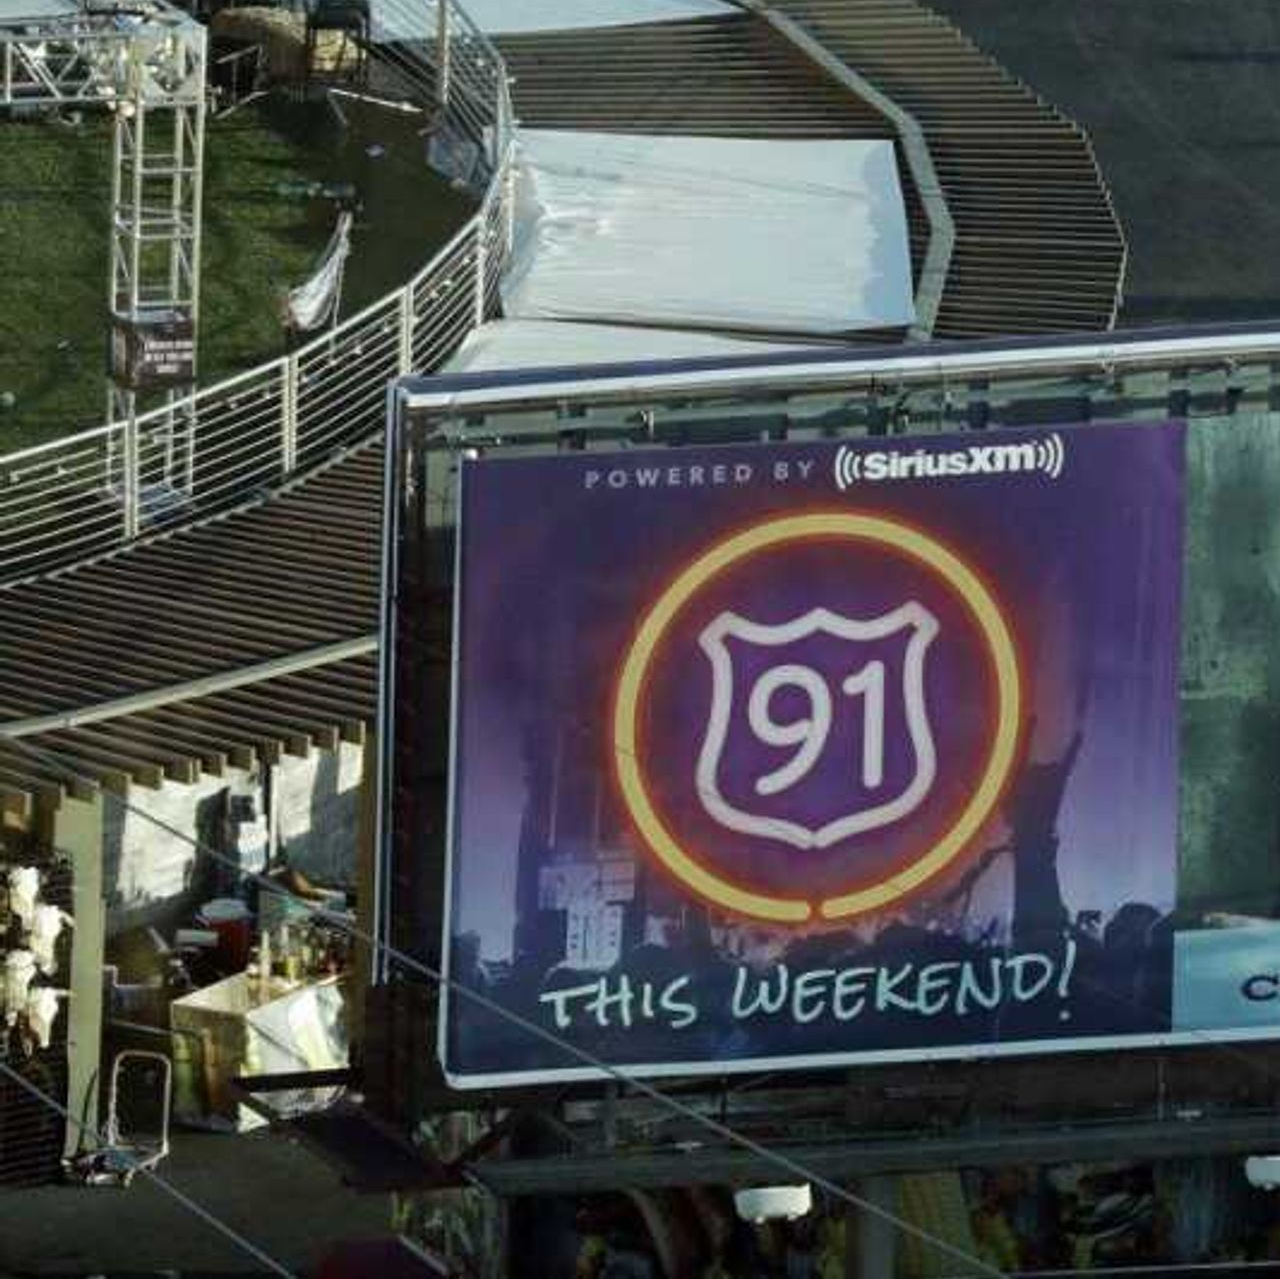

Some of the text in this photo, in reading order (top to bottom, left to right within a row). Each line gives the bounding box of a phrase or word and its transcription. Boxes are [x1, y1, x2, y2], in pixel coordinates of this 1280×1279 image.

[584, 464, 754, 489] POWERED
[773, 460, 813, 481] BY
[748, 660, 885, 796] 91
[539, 939, 1077, 1029] THIS WEEKEND!
